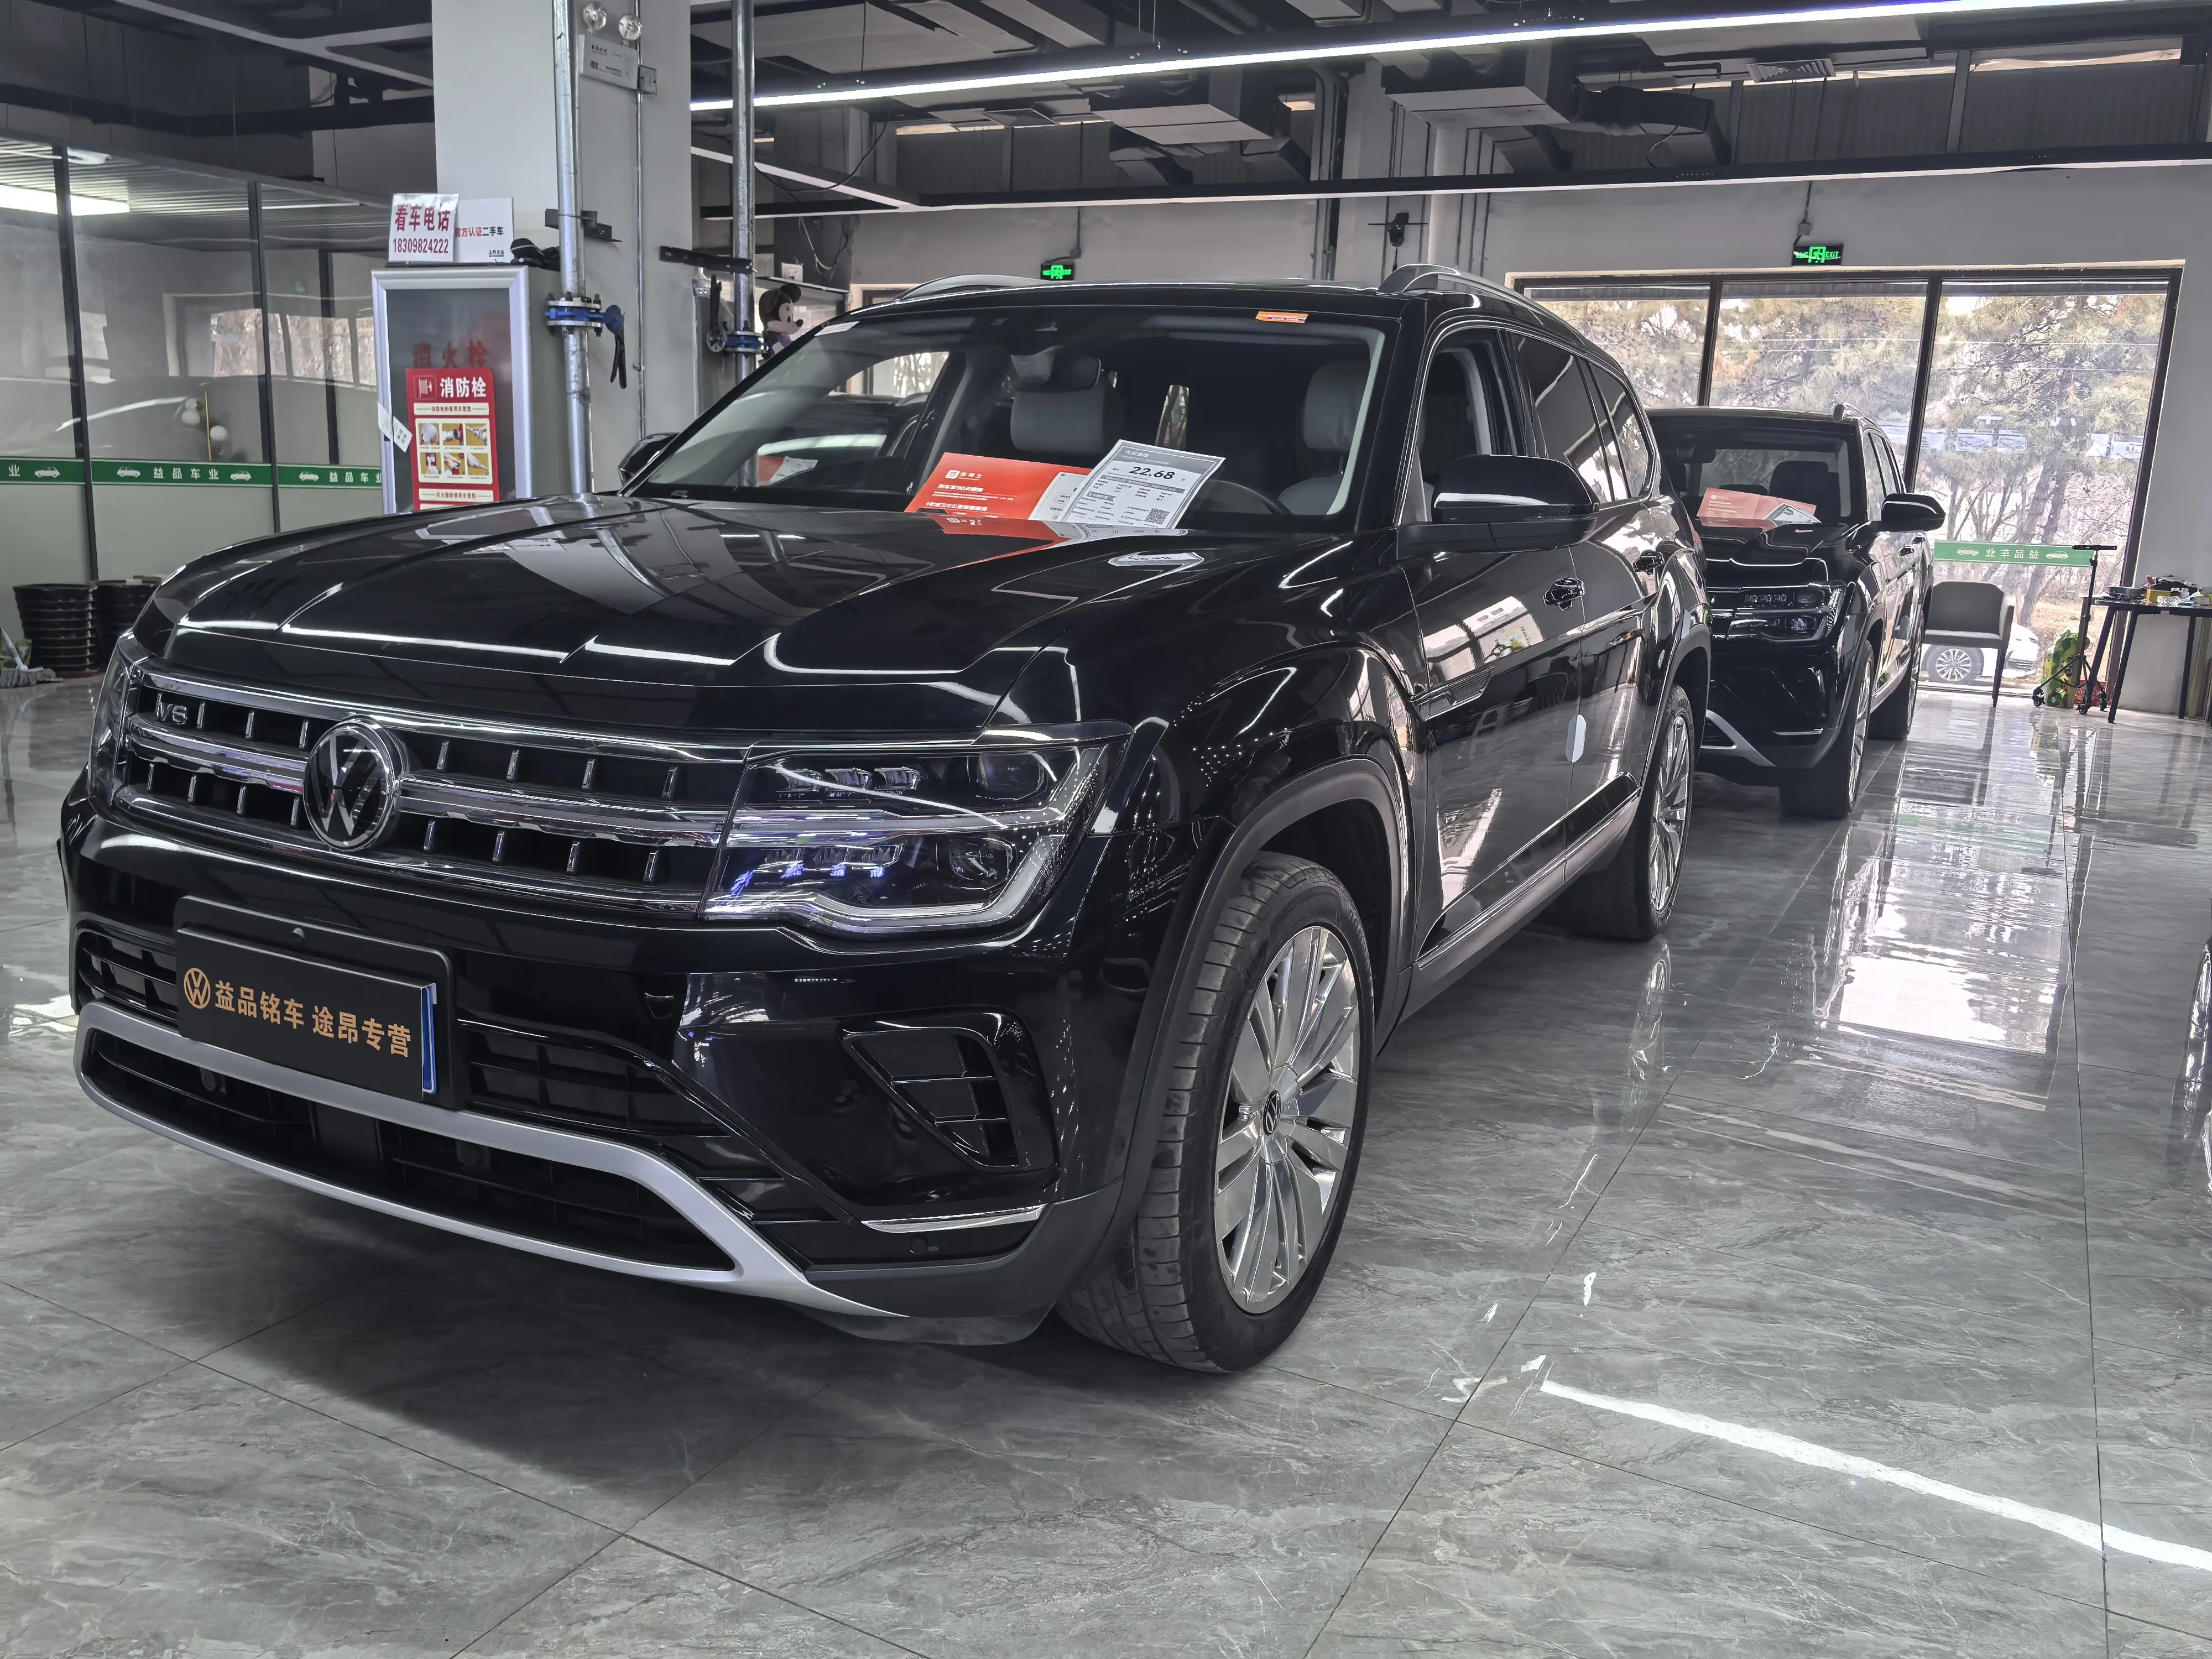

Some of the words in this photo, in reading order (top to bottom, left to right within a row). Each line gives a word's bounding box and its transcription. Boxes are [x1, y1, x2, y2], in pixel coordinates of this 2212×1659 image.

[395, 202, 451, 232] 看车电话
[393, 238, 449, 254] 18309824222
[440, 377, 487, 398] 消防栓
[153, 467, 220, 480] 益品车业
[1129, 466, 1175, 479] 22.68
[155, 692, 187, 725] V6
[215, 980, 304, 1029] 益品铭车
[312, 1005, 411, 1057] 途昂专营
